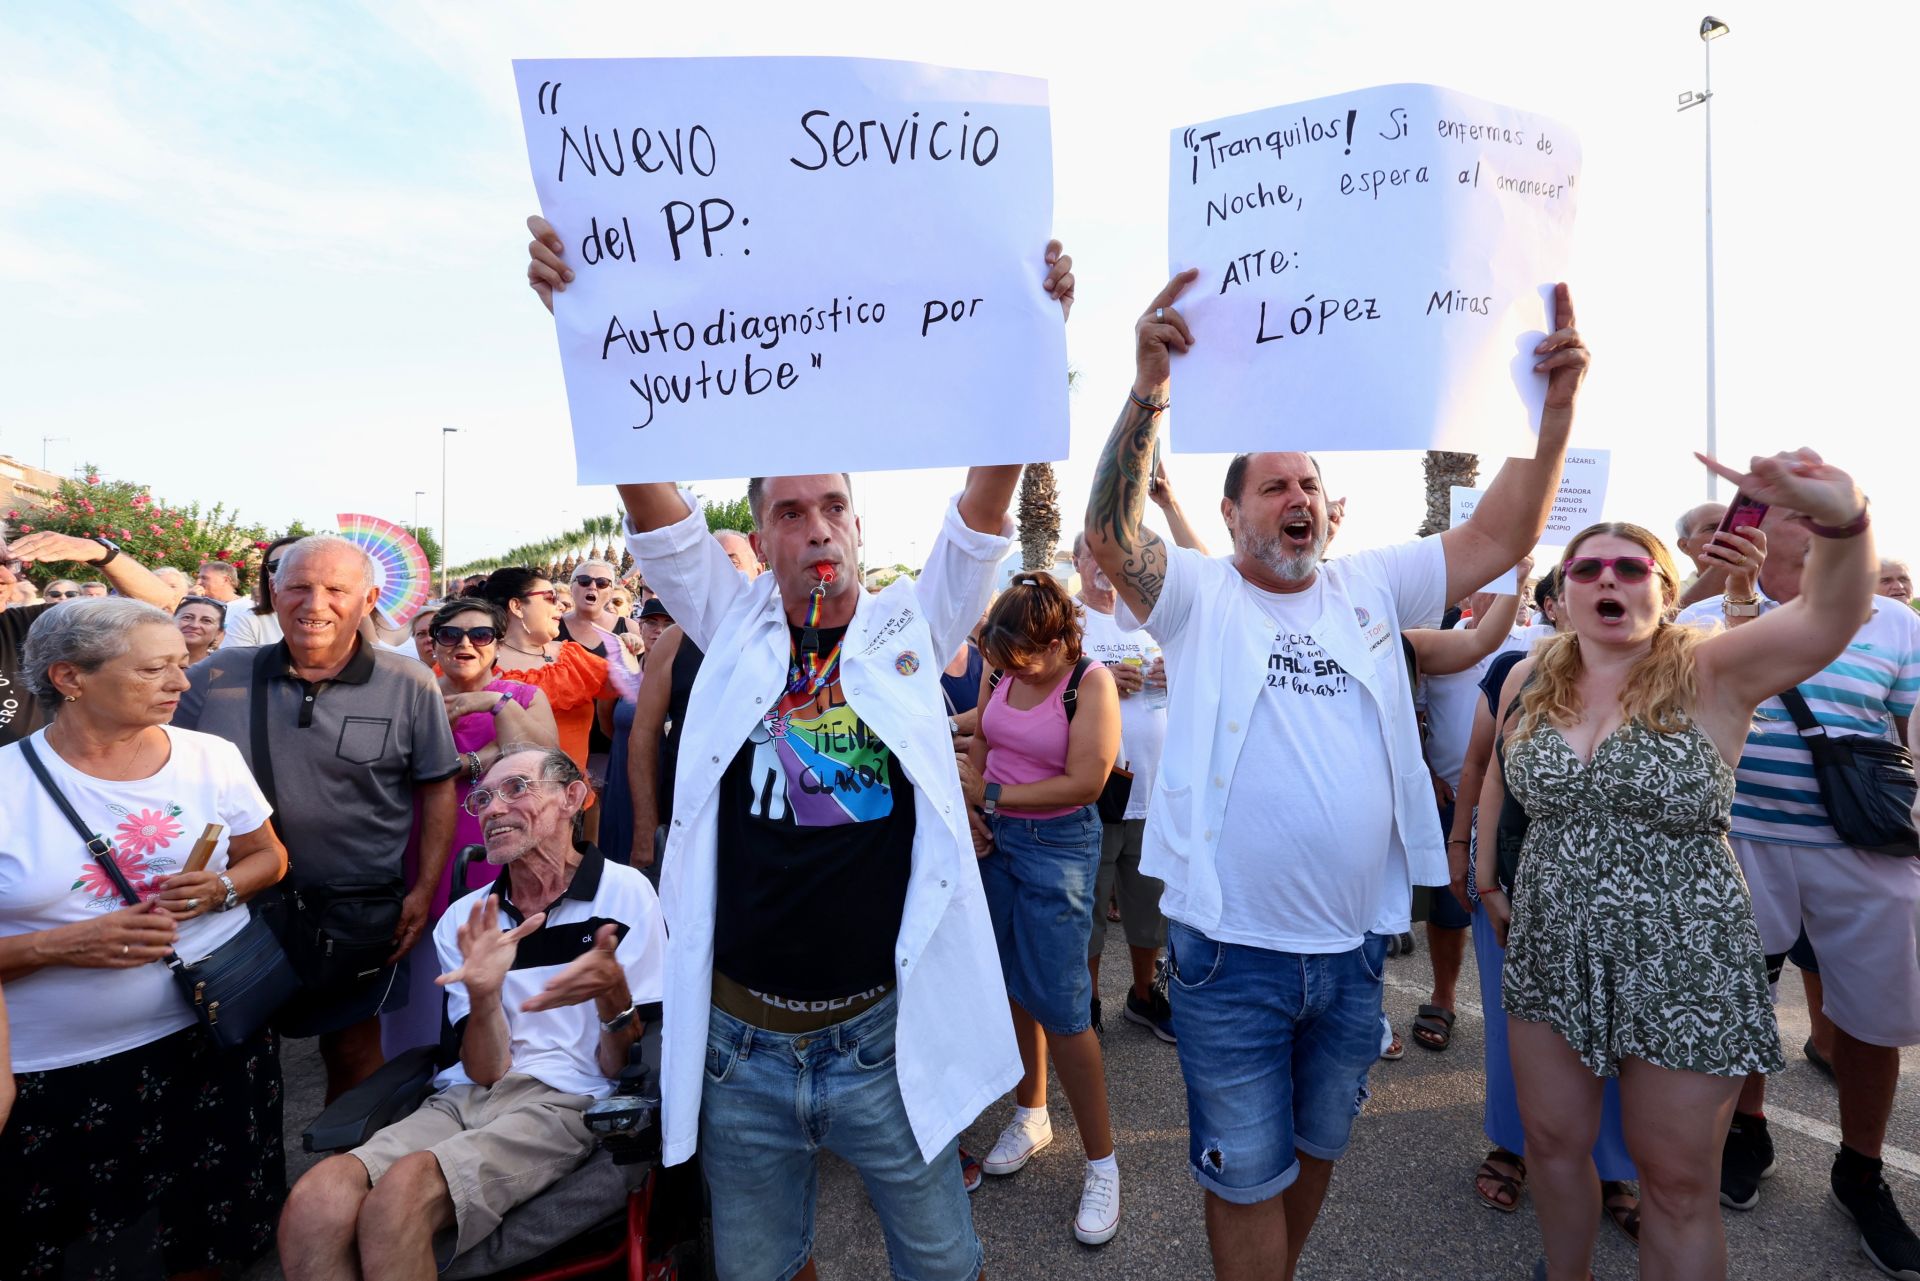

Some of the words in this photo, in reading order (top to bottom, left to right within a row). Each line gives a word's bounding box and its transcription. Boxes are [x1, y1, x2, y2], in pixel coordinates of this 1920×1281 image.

[1379, 107, 1409, 142] Si
[1437, 117, 1525, 146] enfermas
[1536, 132, 1554, 155] de
[790, 110, 1000, 170] Servicio
[1206, 182, 1303, 227] Noche,
[1339, 164, 1430, 200] espera
[1458, 160, 1481, 188] al
[581, 216, 637, 266] del
[660, 198, 751, 261] PP:
[1425, 289, 1493, 317] Miras
[921, 297, 984, 338] por
[1564, 456, 1596, 465] LCÁZARES
[1558, 487, 1592, 495] ERADORA
[1460, 500, 1474, 509] LOS
[1554, 496, 1583, 504] ESIDUOS
[1551, 505, 1577, 513] ITARIOS
[1545, 524, 1571, 532] NICIPIO
[1266, 674, 1288, 690] 24
[582, 933, 593, 943] ck
